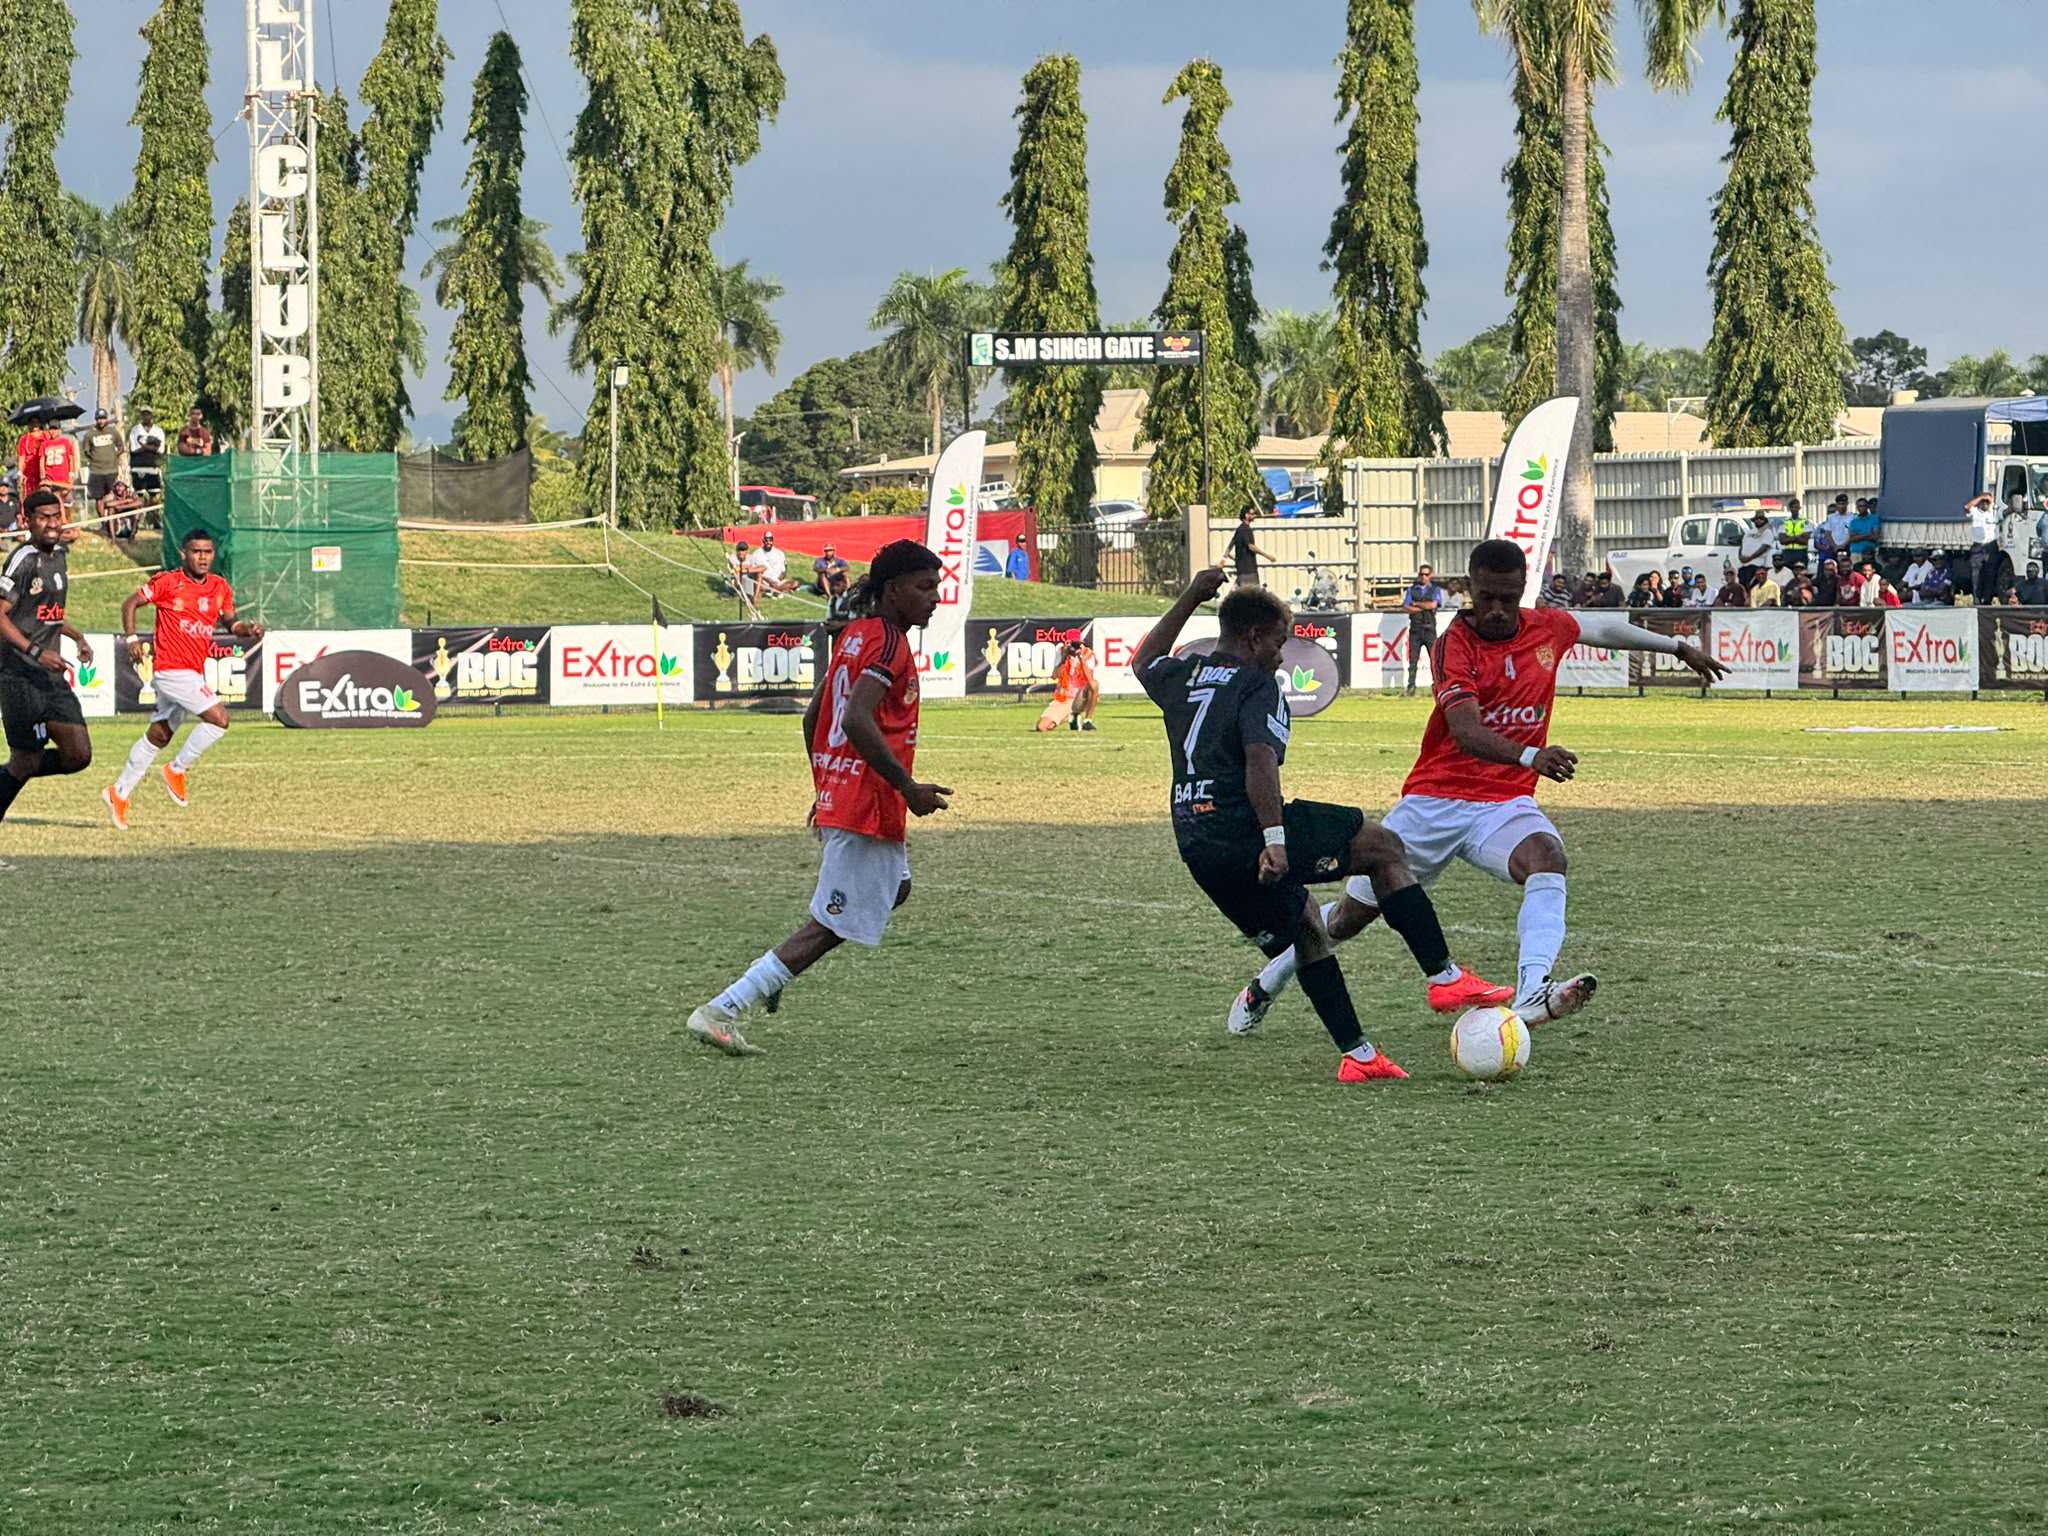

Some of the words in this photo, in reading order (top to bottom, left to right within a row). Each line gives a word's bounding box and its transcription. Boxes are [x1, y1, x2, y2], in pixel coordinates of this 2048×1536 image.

[258, 144, 311, 409] CLUB
[995, 337, 1037, 360] S.M
[1040, 337, 1102, 360] SINGH
[1105, 336, 1154, 359] GATE
[489, 635, 525, 651] Extra
[767, 632, 803, 646] Extra
[1294, 622, 1327, 638] Extra
[1717, 625, 1776, 664] Extra
[1893, 623, 1959, 665] Extra
[208, 642, 234, 657] tra
[563, 640, 657, 677] Extra
[737, 646, 815, 684] BOG
[1007, 642, 1061, 678] BO
[1504, 654, 1516, 681] 4
[1826, 634, 1880, 673] BOG
[2009, 633, 2048, 673] BO
[457, 651, 538, 690] BOG
[1197, 666, 1239, 683] BOG
[298, 674, 395, 712] Extra
[1183, 688, 1216, 775] 7
[1482, 703, 1536, 725] xtra
